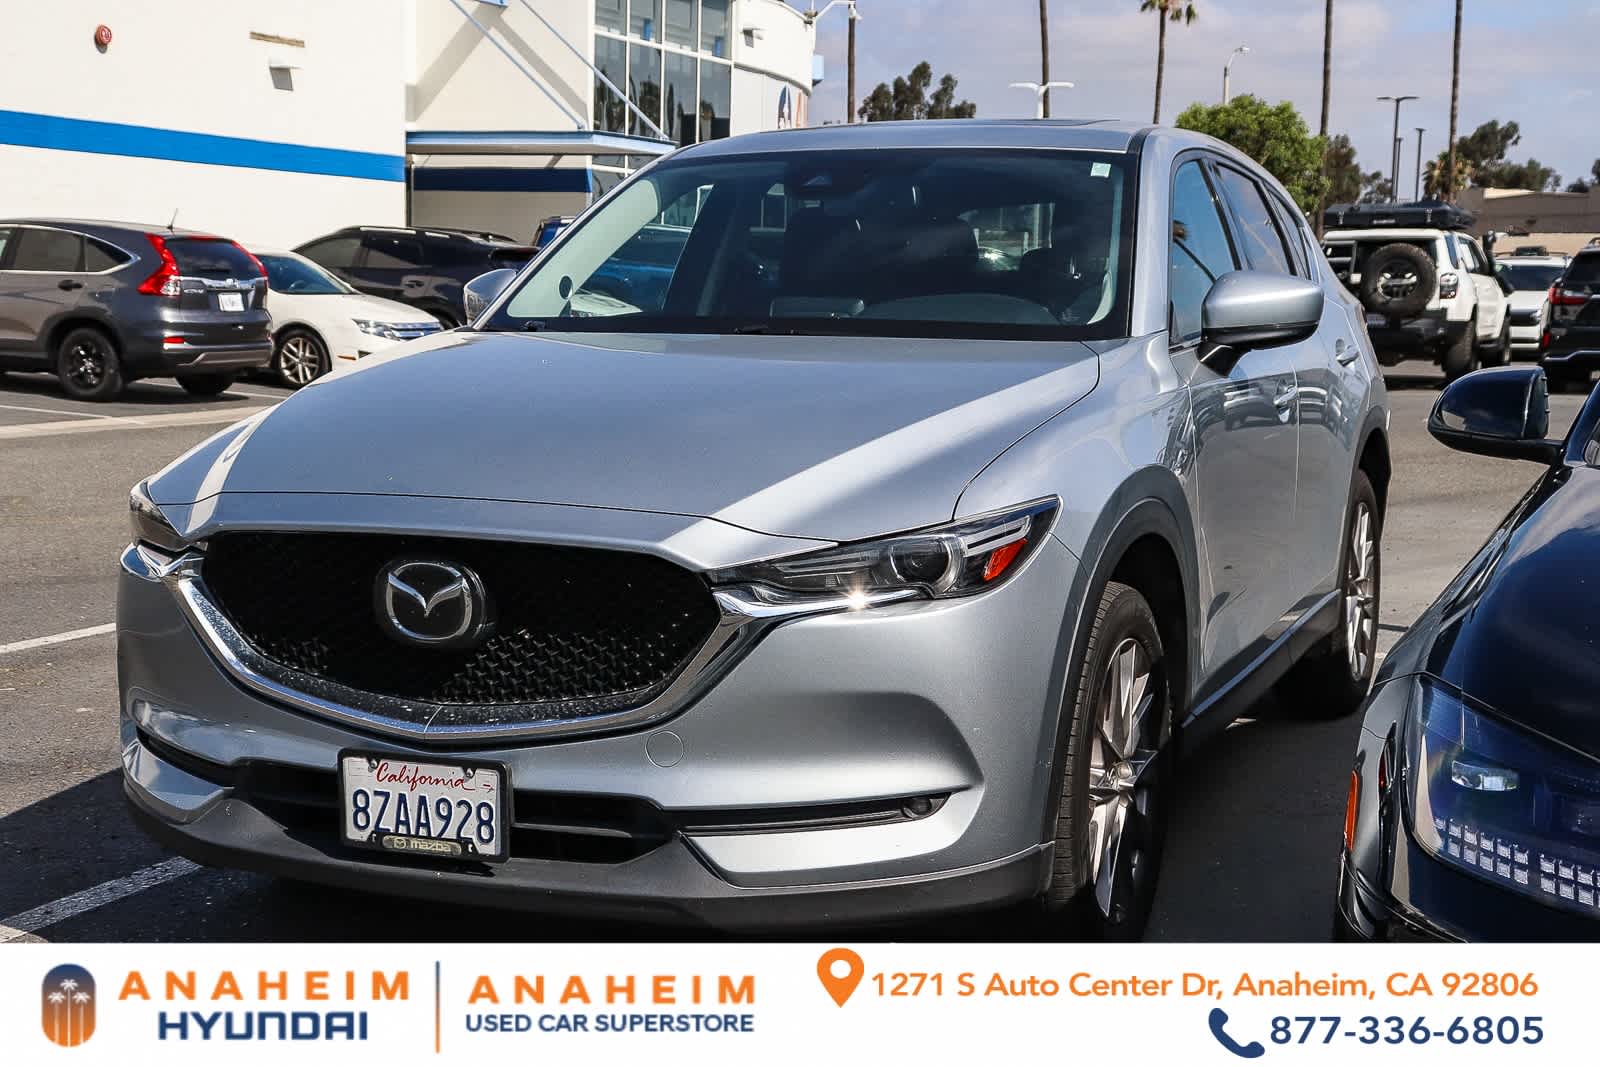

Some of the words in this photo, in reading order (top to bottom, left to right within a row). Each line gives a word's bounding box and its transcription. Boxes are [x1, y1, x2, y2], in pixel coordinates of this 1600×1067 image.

[376, 762, 475, 792] California
[352, 788, 494, 843] 8ZAA928
[410, 839, 452, 852] mazda
